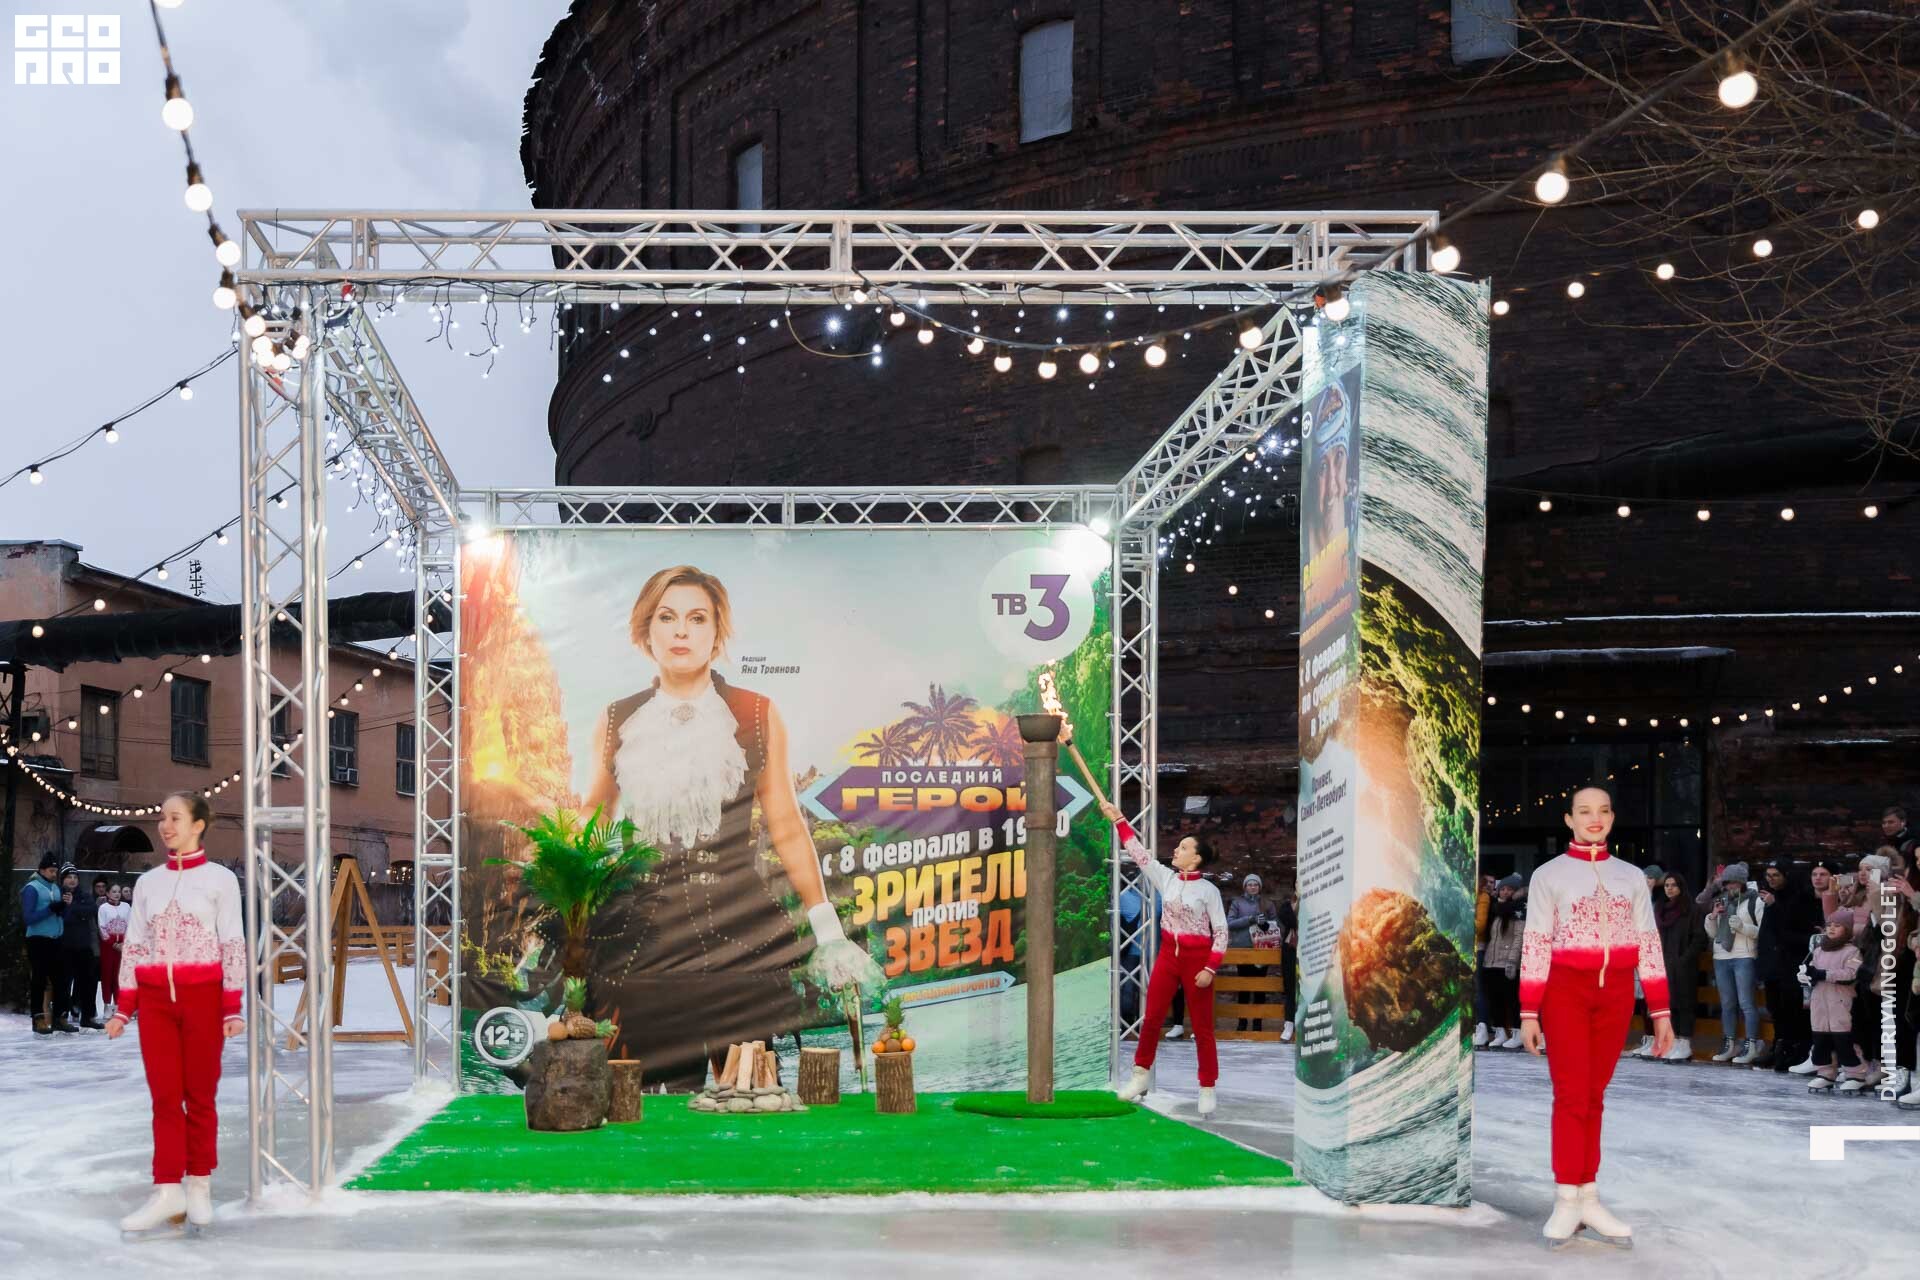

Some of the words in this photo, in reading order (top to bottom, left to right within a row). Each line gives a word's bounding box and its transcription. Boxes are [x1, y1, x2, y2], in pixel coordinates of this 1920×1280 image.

[741, 664, 758, 674] Яна
[760, 664, 800, 675] Троянова
[881, 768, 1003, 784] ПОСЛЕДНИЙ
[839, 845, 856, 875] 8
[862, 830, 971, 872] февраля
[884, 908, 1015, 977] ЗВЕЗД
[484, 1025, 525, 1046] 12+
